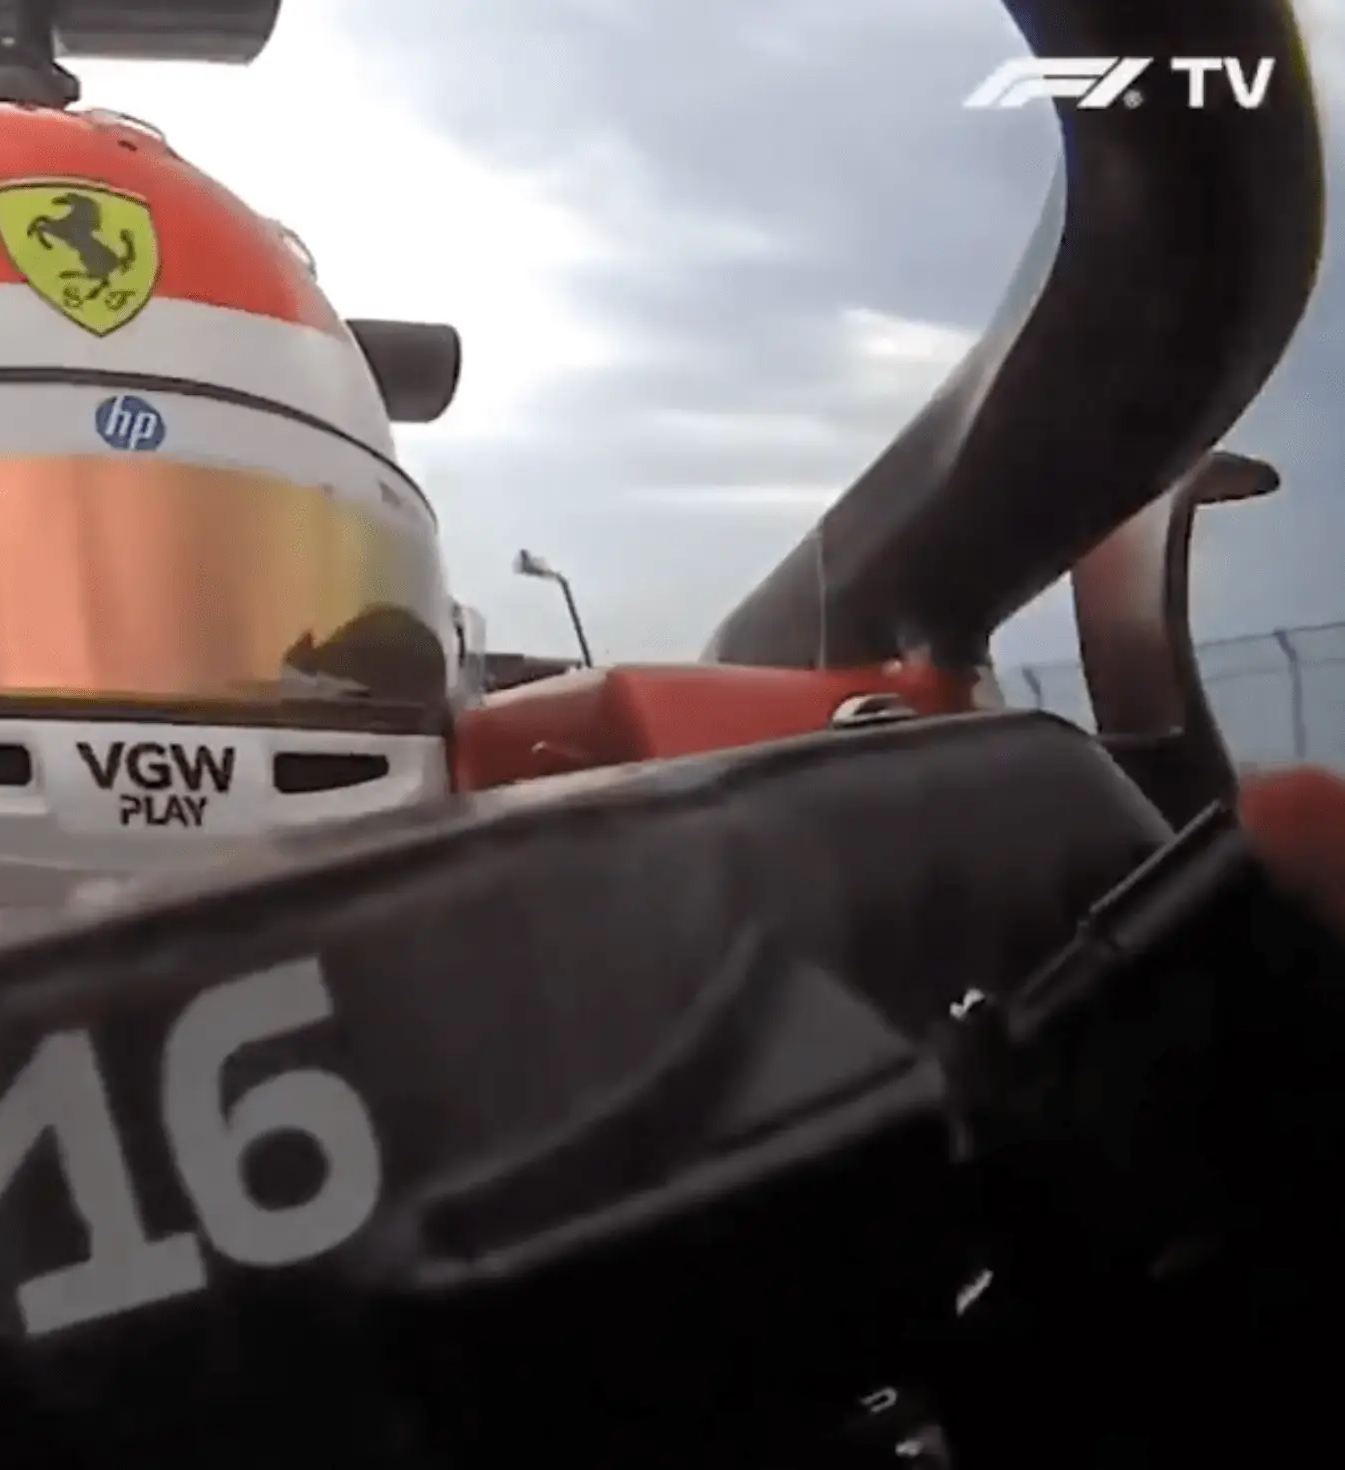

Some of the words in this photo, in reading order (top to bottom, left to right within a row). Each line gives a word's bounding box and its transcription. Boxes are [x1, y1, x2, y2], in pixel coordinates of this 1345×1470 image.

[104, 395, 156, 450] hp
[76, 741, 236, 793] VGW
[120, 794, 208, 827] PLAY
